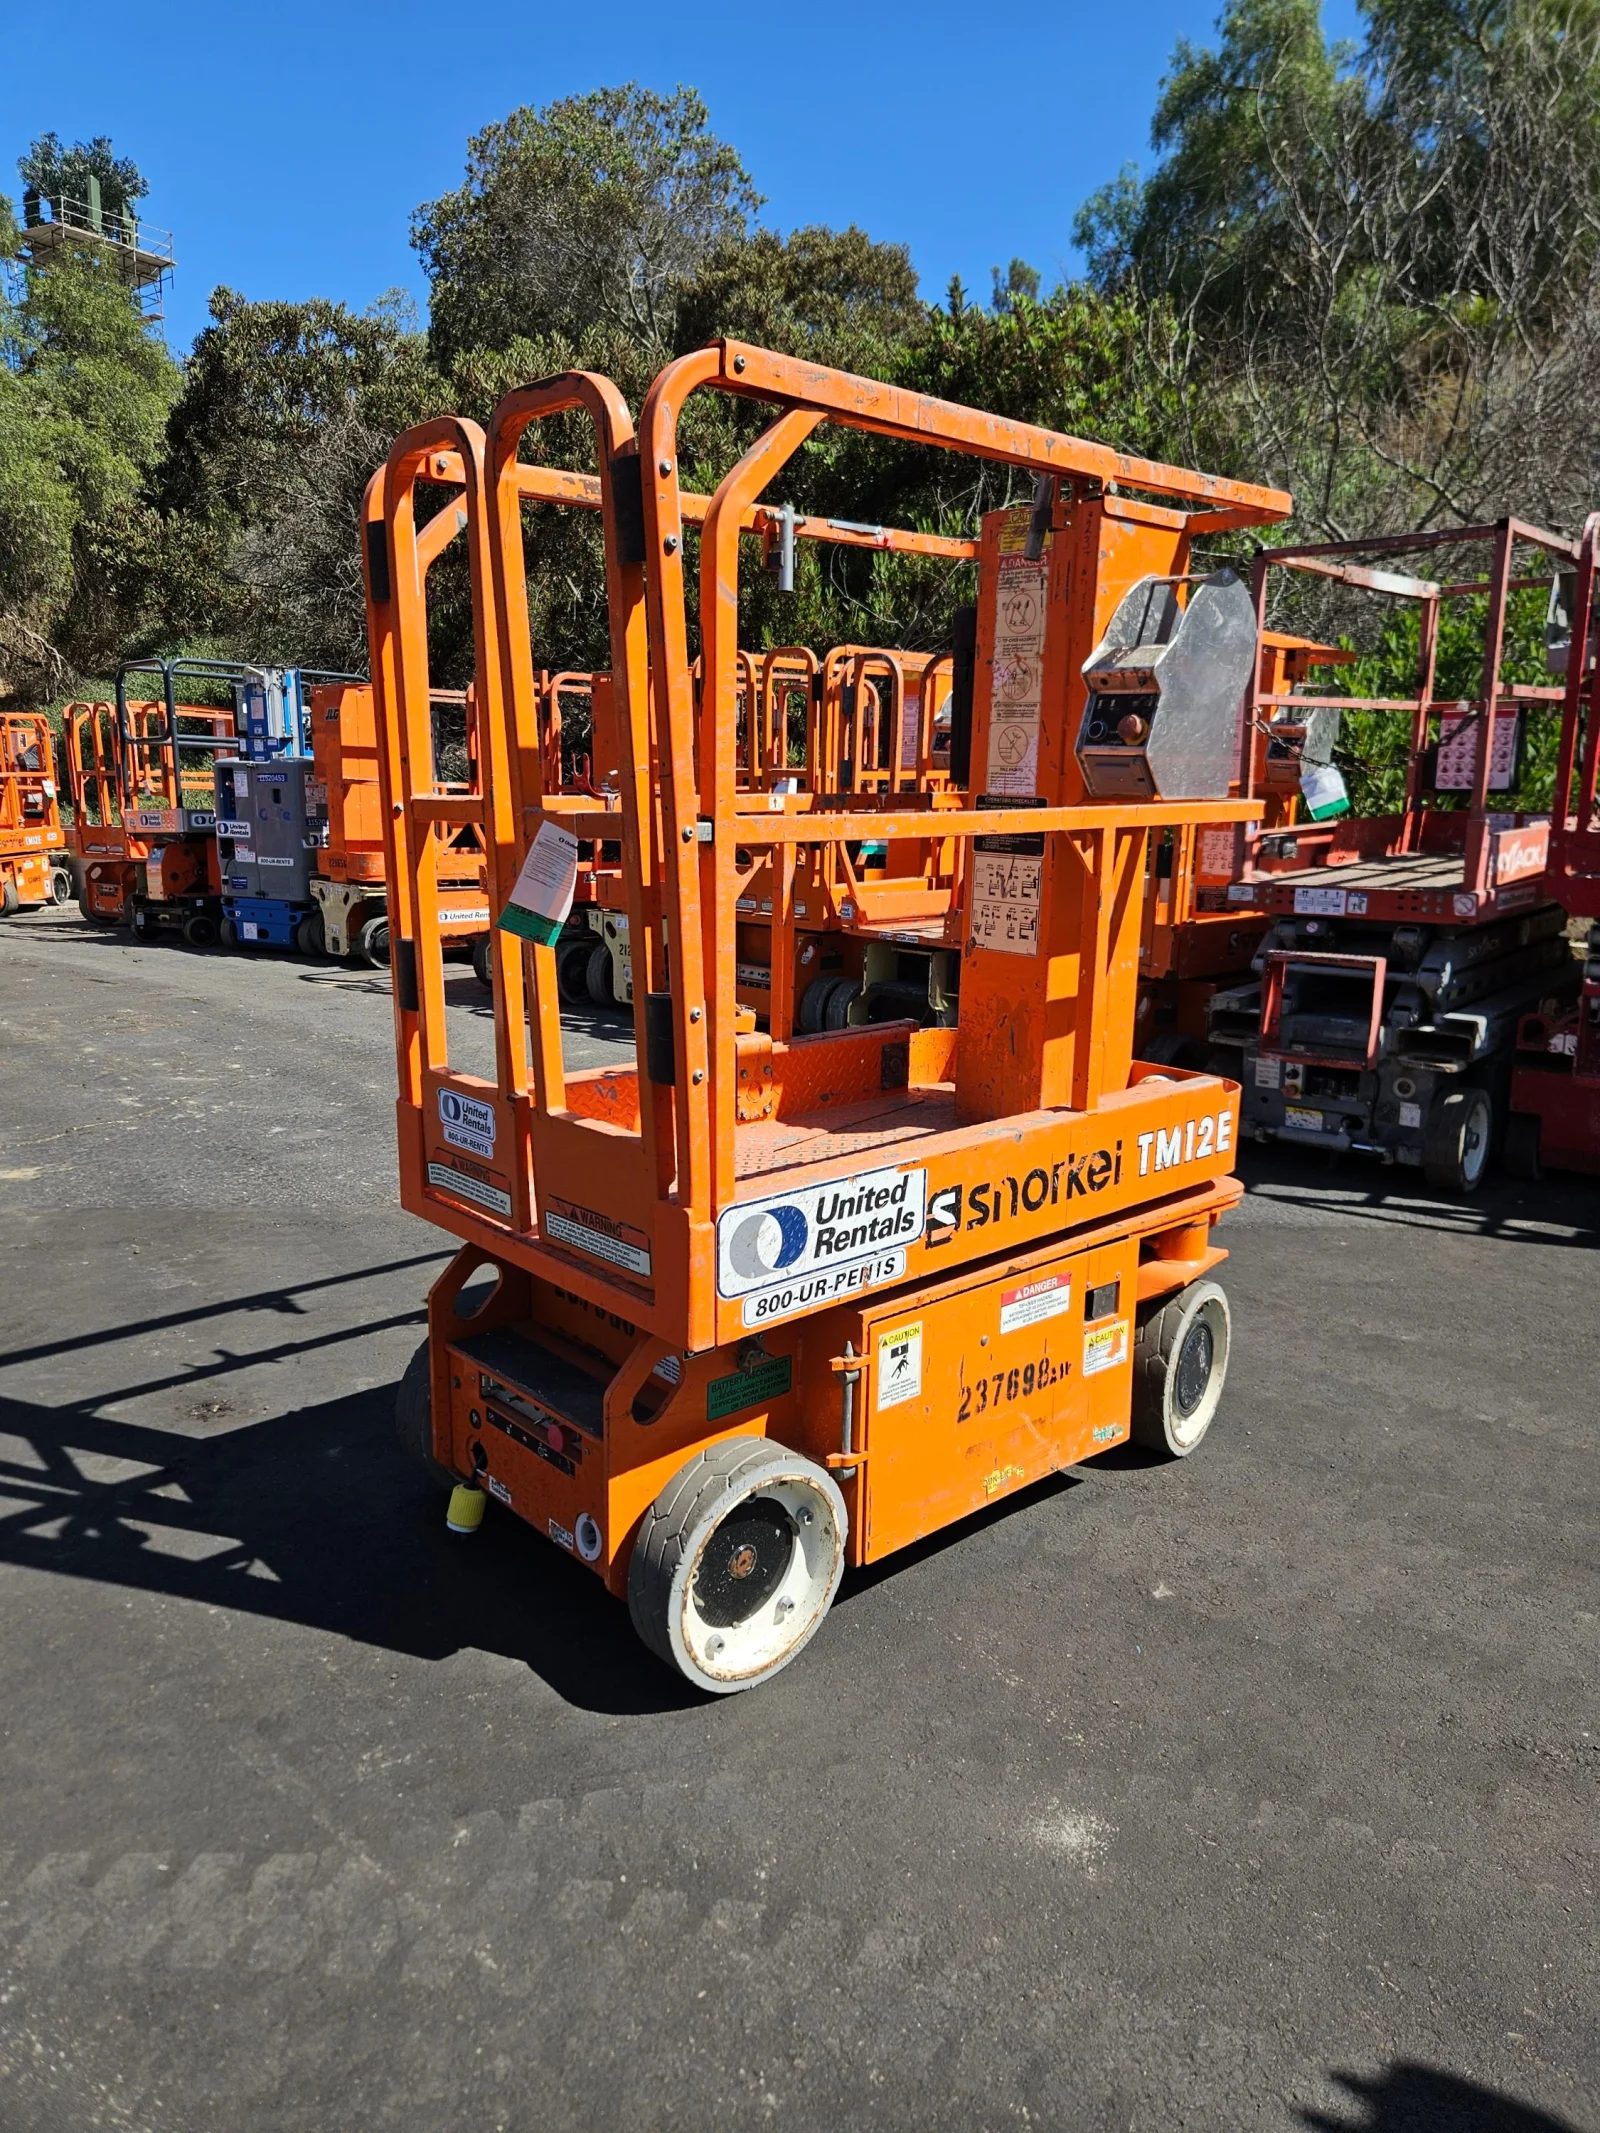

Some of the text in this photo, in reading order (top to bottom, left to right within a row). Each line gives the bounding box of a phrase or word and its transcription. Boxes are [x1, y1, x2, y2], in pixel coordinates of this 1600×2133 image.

[325, 708, 339, 721] JLG
[450, 912, 473, 920] United
[462, 1101, 489, 1121] United
[462, 1114, 491, 1135] Rentals
[448, 1131, 489, 1153] 800-UR-RENTS
[1137, 1110, 1232, 1177] TM12E
[815, 1174, 910, 1225] United
[579, 1209, 623, 1238] WARNING
[814, 1207, 915, 1259] Rentals
[1023, 1277, 1058, 1296] DANGER
[889, 1326, 920, 1344] CAUTION
[1095, 1326, 1125, 1344] CAUTN
[712, 1375, 742, 1392] BATTERY
